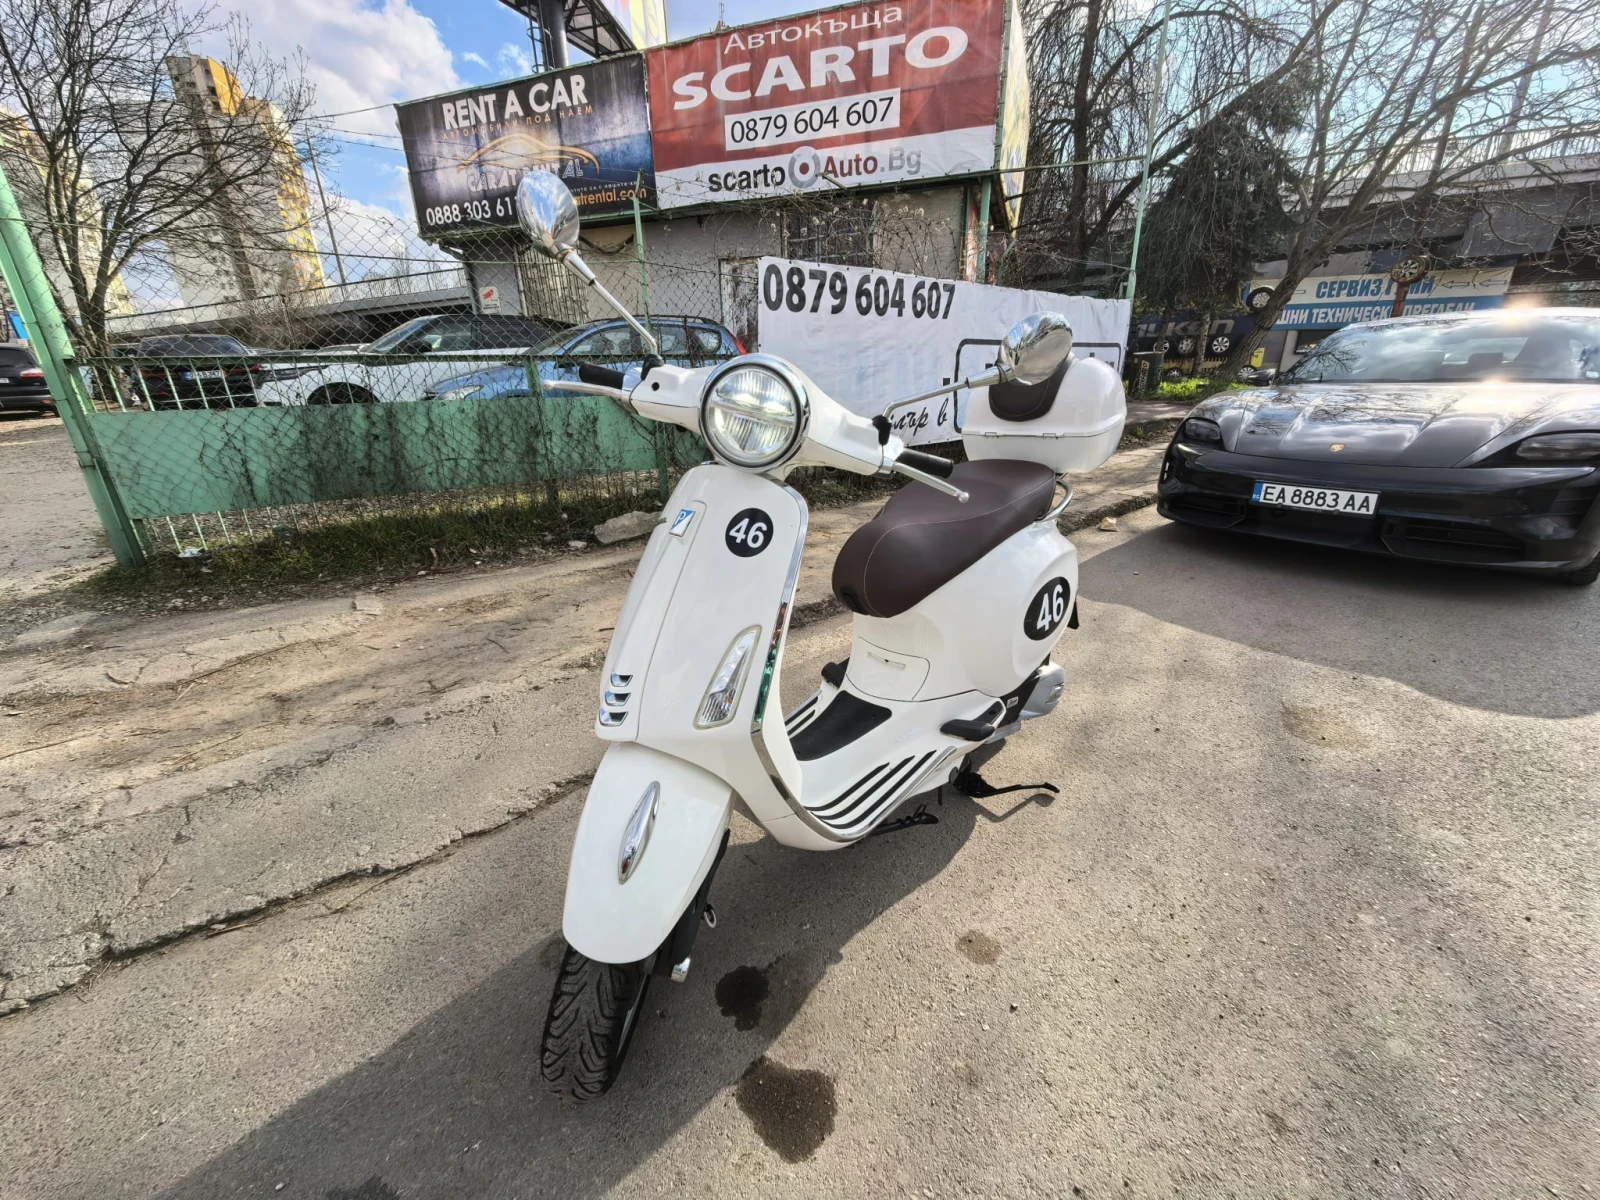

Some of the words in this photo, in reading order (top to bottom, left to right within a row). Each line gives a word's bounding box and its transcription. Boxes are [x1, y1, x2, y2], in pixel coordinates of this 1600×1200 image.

[724, 7, 902, 54] Автокъща
[672, 26, 969, 110] SCARTO
[443, 93, 496, 130] RENT
[504, 89, 525, 120] A
[528, 74, 588, 113] CAR
[730, 116, 787, 143] 0879
[793, 106, 839, 134] 604
[846, 97, 894, 126] 607
[442, 118, 519, 142] АВТОМОБИЛИ
[526, 113, 551, 126] ПОД
[559, 104, 594, 119] НАЕМ
[466, 169, 518, 192] CARAT
[708, 164, 786, 193] scarto
[426, 207, 462, 226] 0888
[466, 201, 492, 222] 303
[496, 196, 518, 217] 61
[763, 264, 848, 315] 0879
[855, 275, 905, 317] 604
[911, 281, 956, 320] 607
[1315, 278, 1383, 299] СЕРВИЗ
[1263, 485, 1286, 503] EA
[1290, 489, 1340, 509] 8883
[1343, 494, 1370, 513] AA
[728, 517, 767, 549] 46
[1036, 584, 1064, 632] 46
